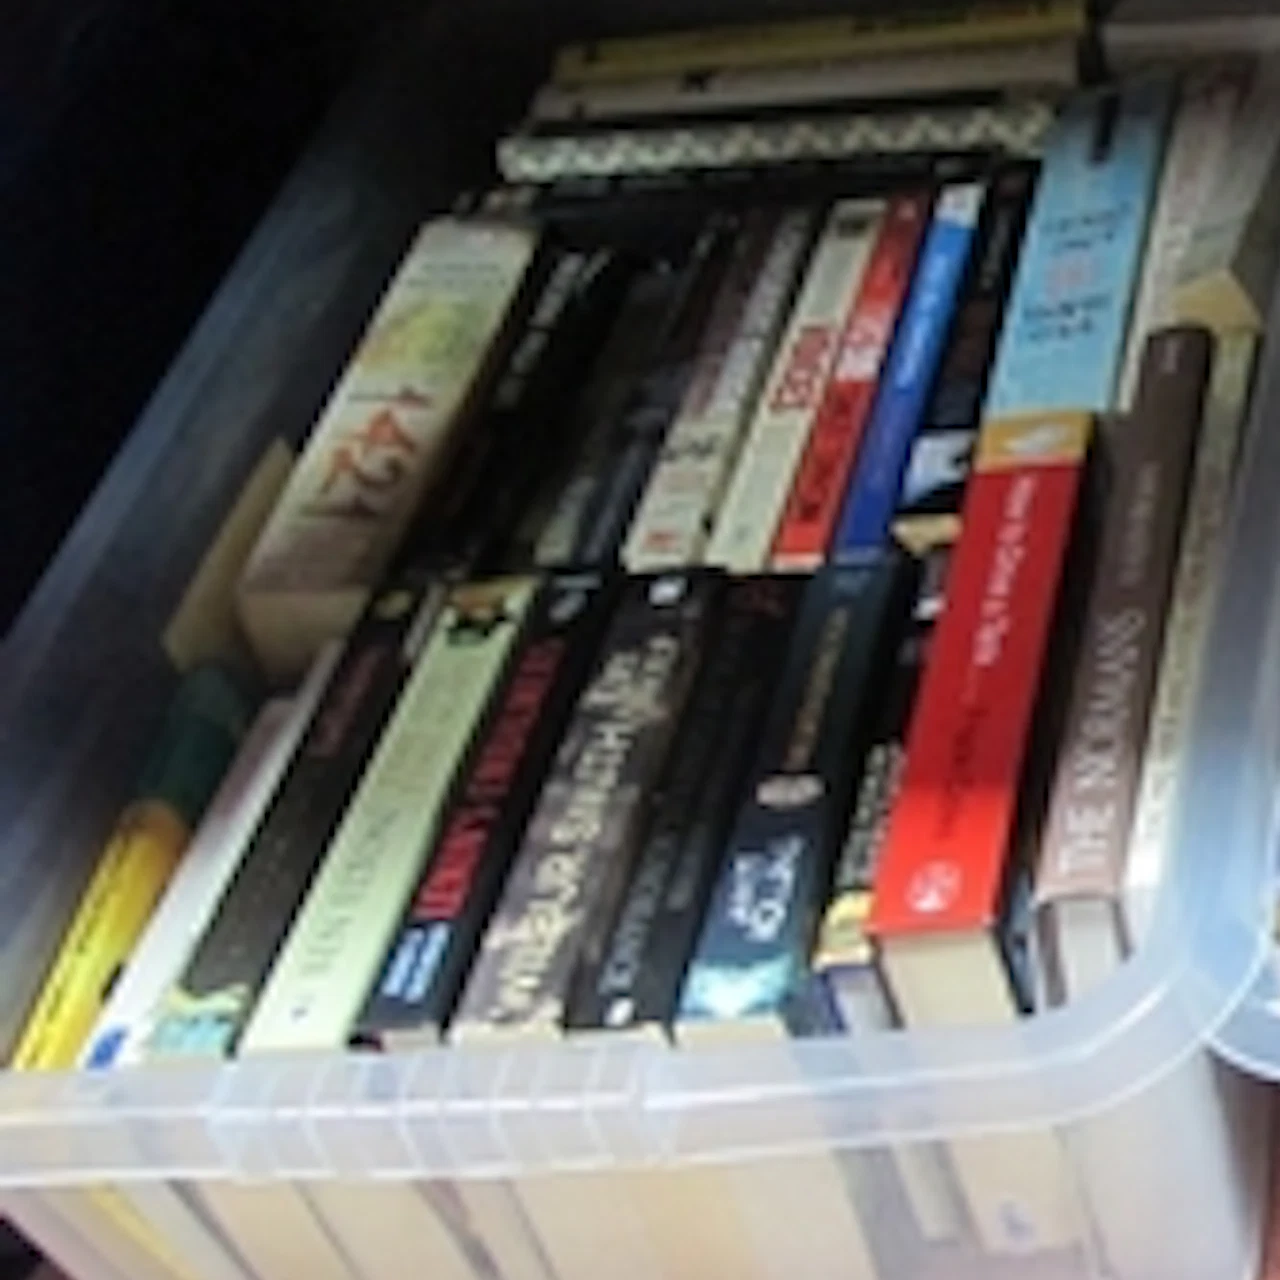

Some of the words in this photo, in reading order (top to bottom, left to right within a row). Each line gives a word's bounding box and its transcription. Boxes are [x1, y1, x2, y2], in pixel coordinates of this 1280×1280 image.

[286, 386, 444, 525] 1421
[1061, 607, 1151, 788] NORMANS
[1053, 803, 1116, 876] THE
